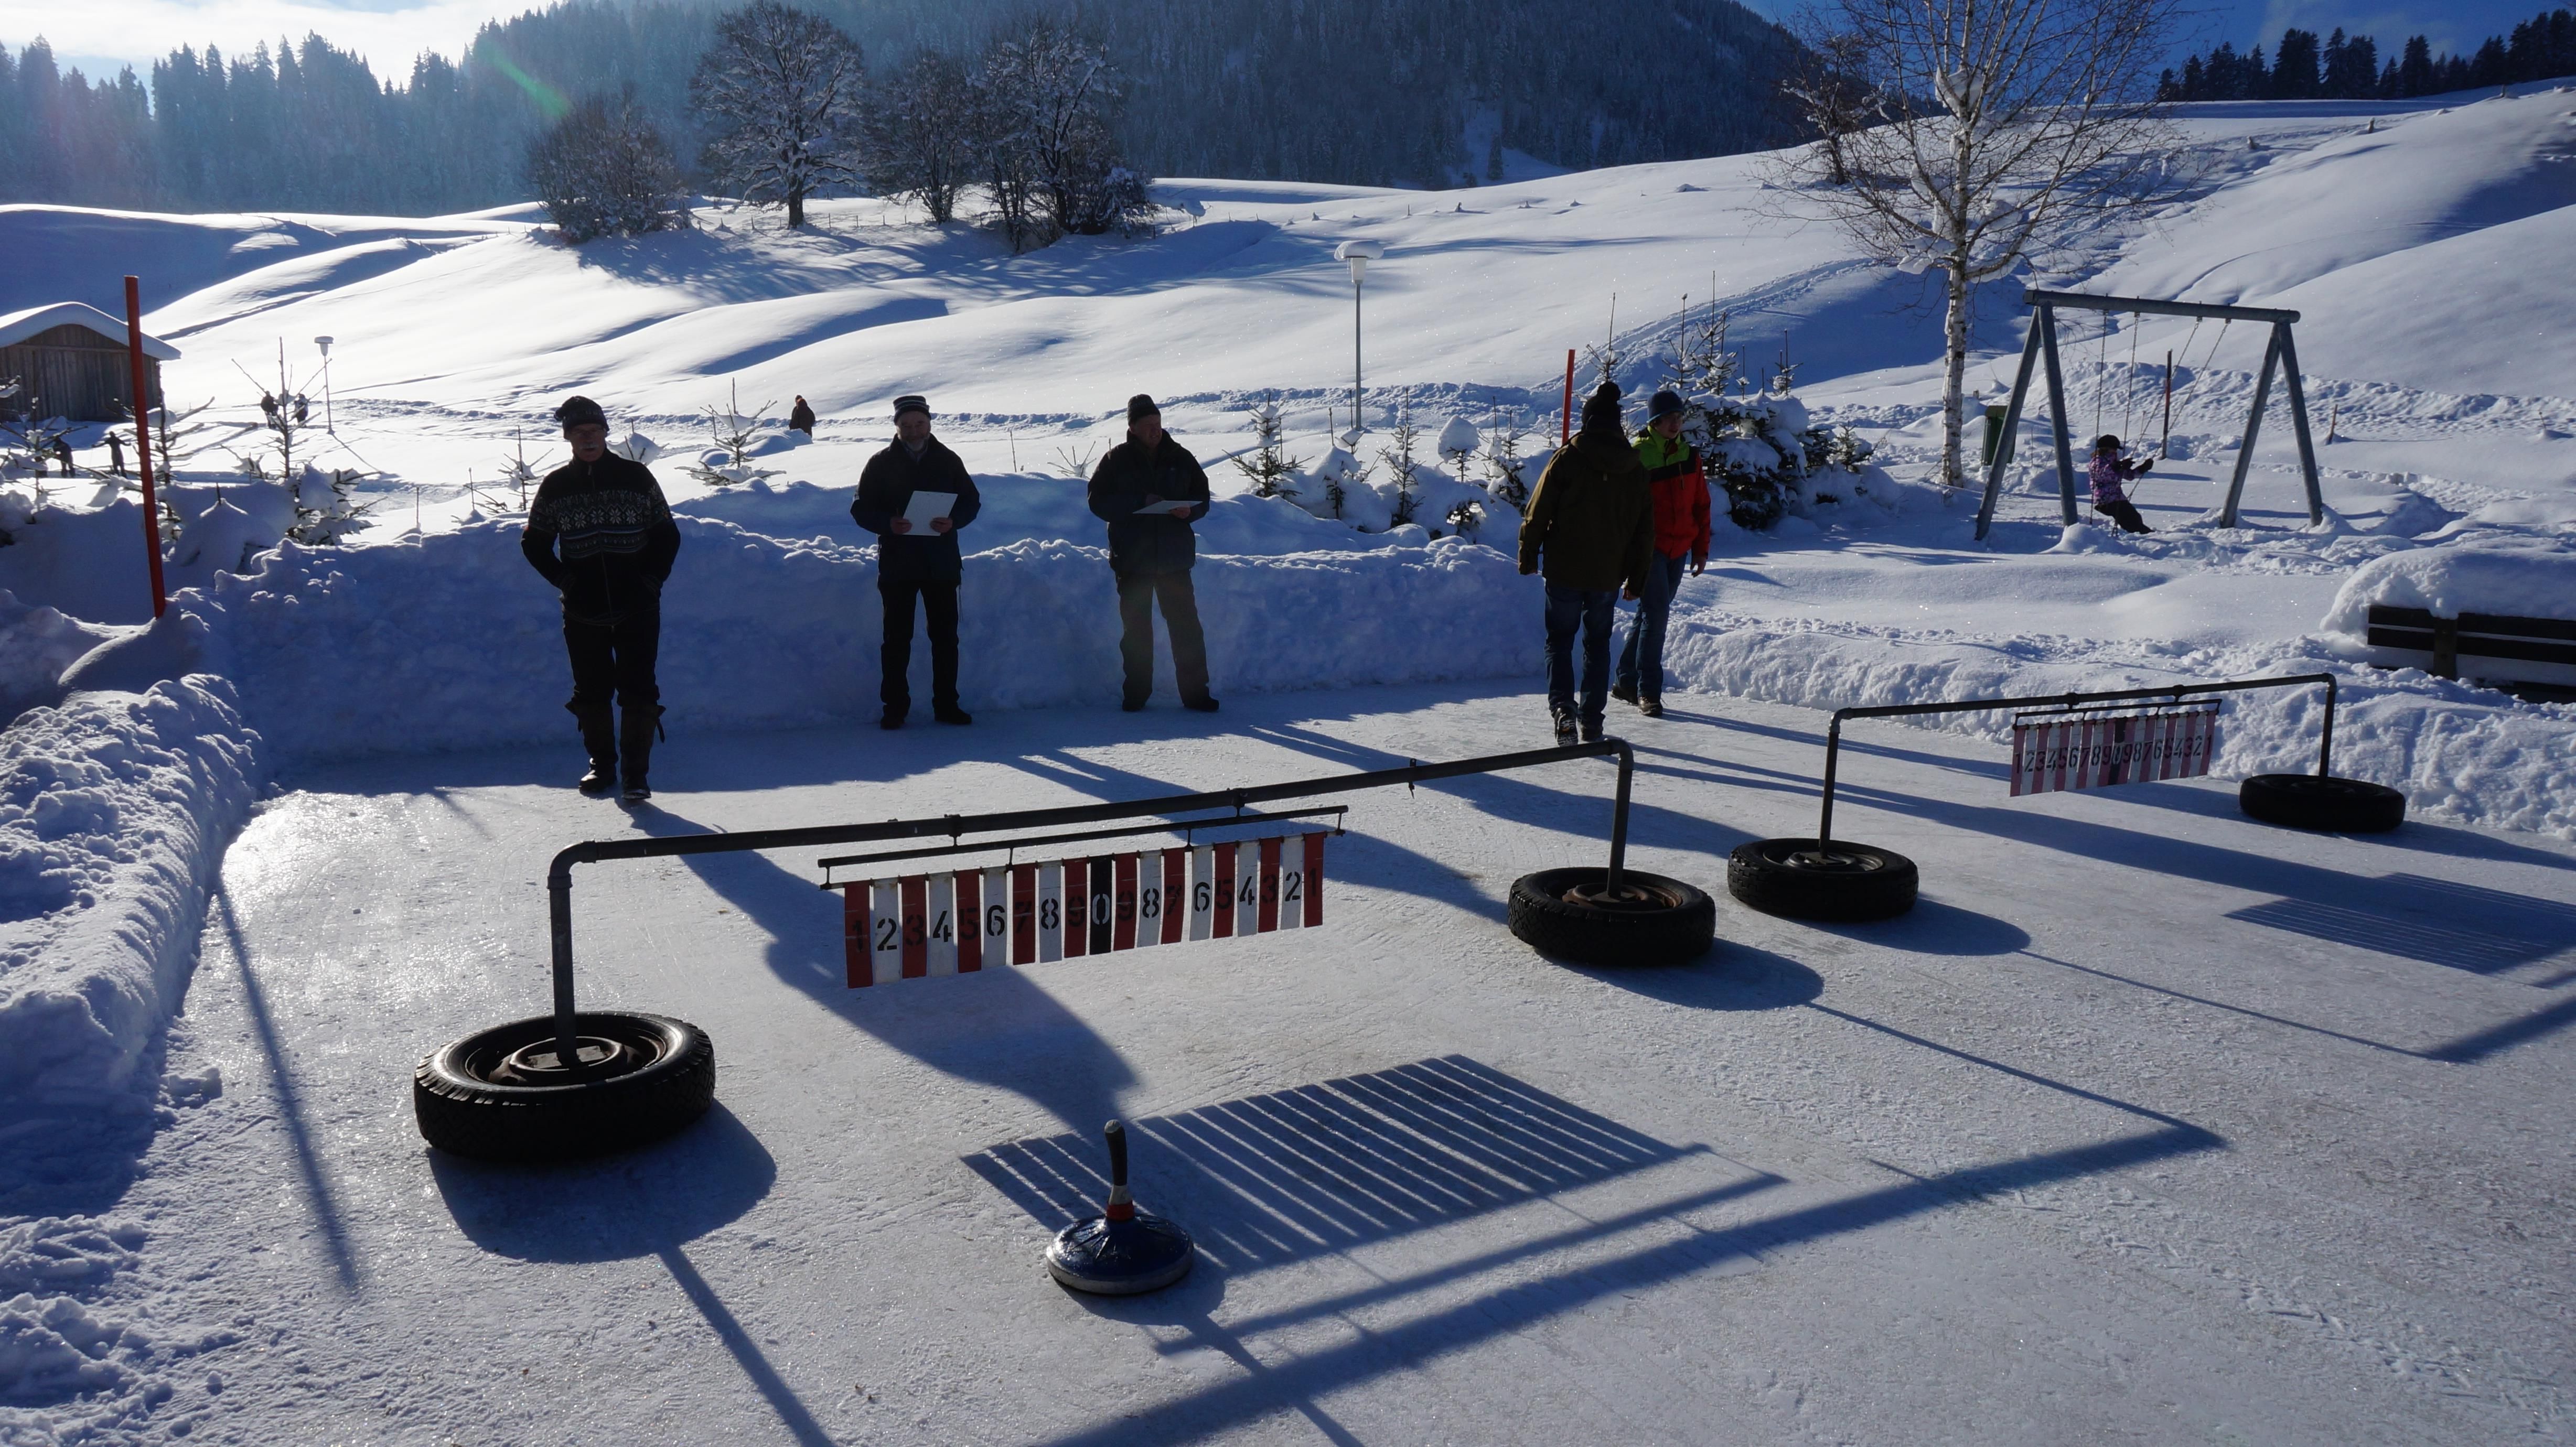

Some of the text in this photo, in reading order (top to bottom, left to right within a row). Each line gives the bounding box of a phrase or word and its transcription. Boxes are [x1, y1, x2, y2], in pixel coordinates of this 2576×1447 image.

[2016, 753, 2021, 774] 1
[2024, 752, 2035, 772] 2
[2035, 751, 2045, 771] 3
[2046, 750, 2056, 773] 4
[2058, 748, 2068, 769] 5
[2069, 746, 2078, 768] 6
[2080, 747, 2091, 768] 7
[2091, 746, 2101, 766] 8
[2102, 746, 2111, 765] 9
[2123, 743, 2132, 763] 9
[2133, 742, 2142, 762] 8
[2143, 741, 2153, 761] 7
[2154, 739, 2162, 760] 6
[2164, 738, 2173, 759] 5
[2173, 739, 2183, 758] 4
[2184, 736, 2193, 757] 3
[2194, 735, 2203, 756] 2
[2206, 735, 2212, 755] 1
[852, 868, 1317, 953] 1 2 3 4 5 6 7 8 9 0 9 8 7 6 5 4 3 2 1
